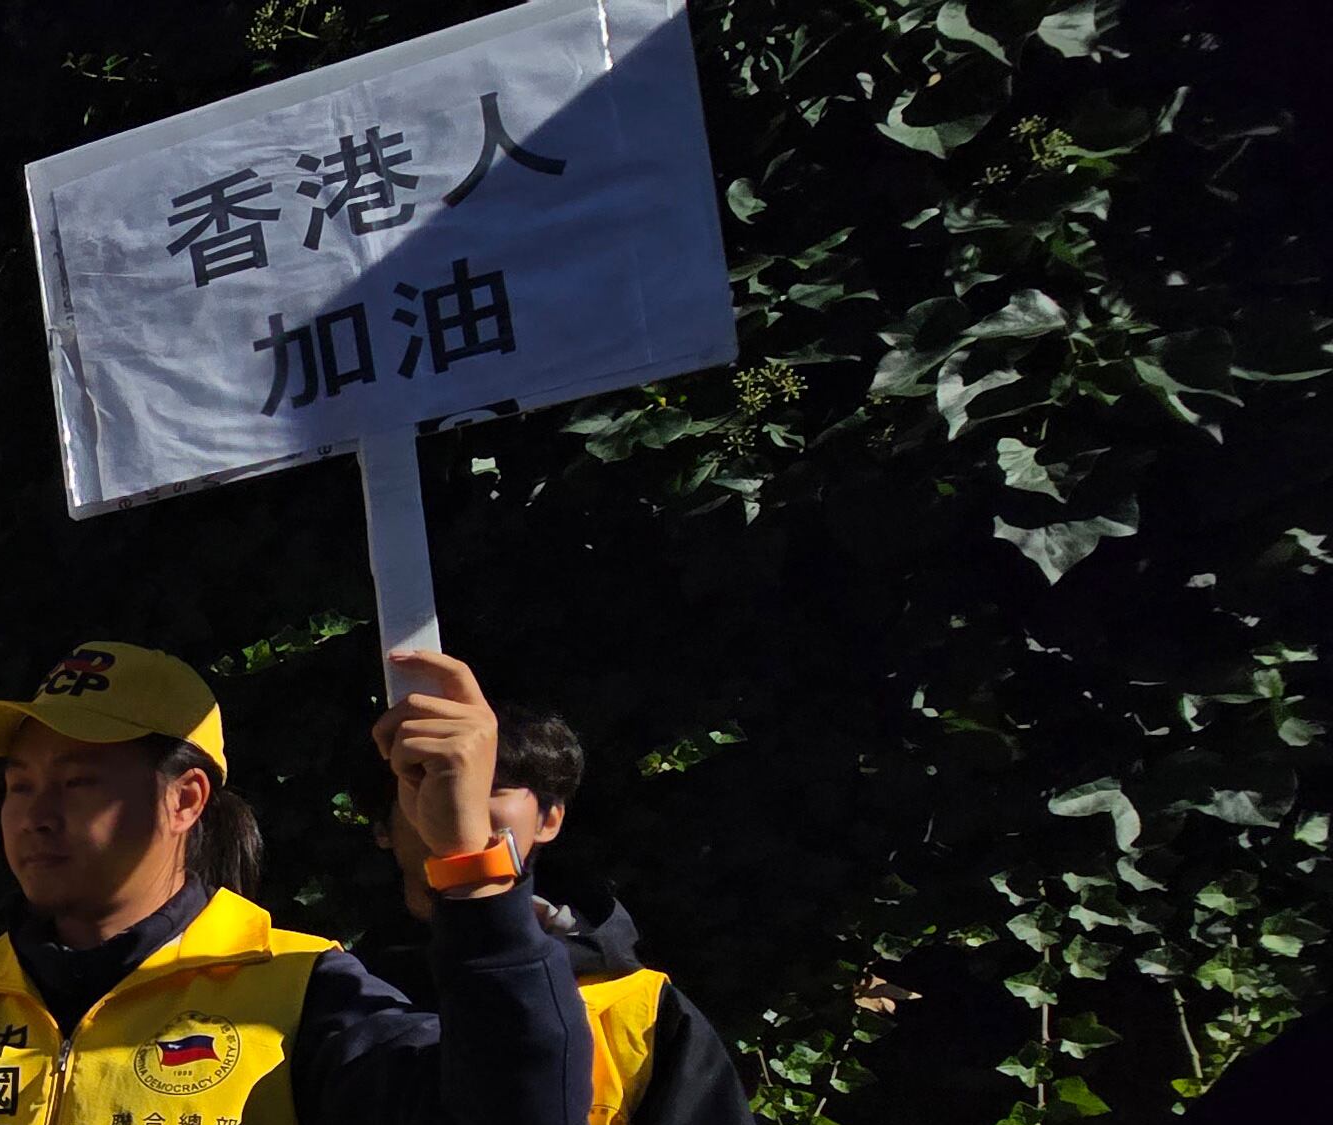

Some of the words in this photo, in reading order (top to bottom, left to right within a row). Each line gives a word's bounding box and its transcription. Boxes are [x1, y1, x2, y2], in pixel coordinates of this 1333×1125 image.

[166, 92, 567, 288] 香港人
[253, 257, 517, 418] 加油
[36, 669, 110, 697] CP
[144, 1074, 213, 1093] DEMOCRACY
[215, 1044, 237, 1078] PARTY
